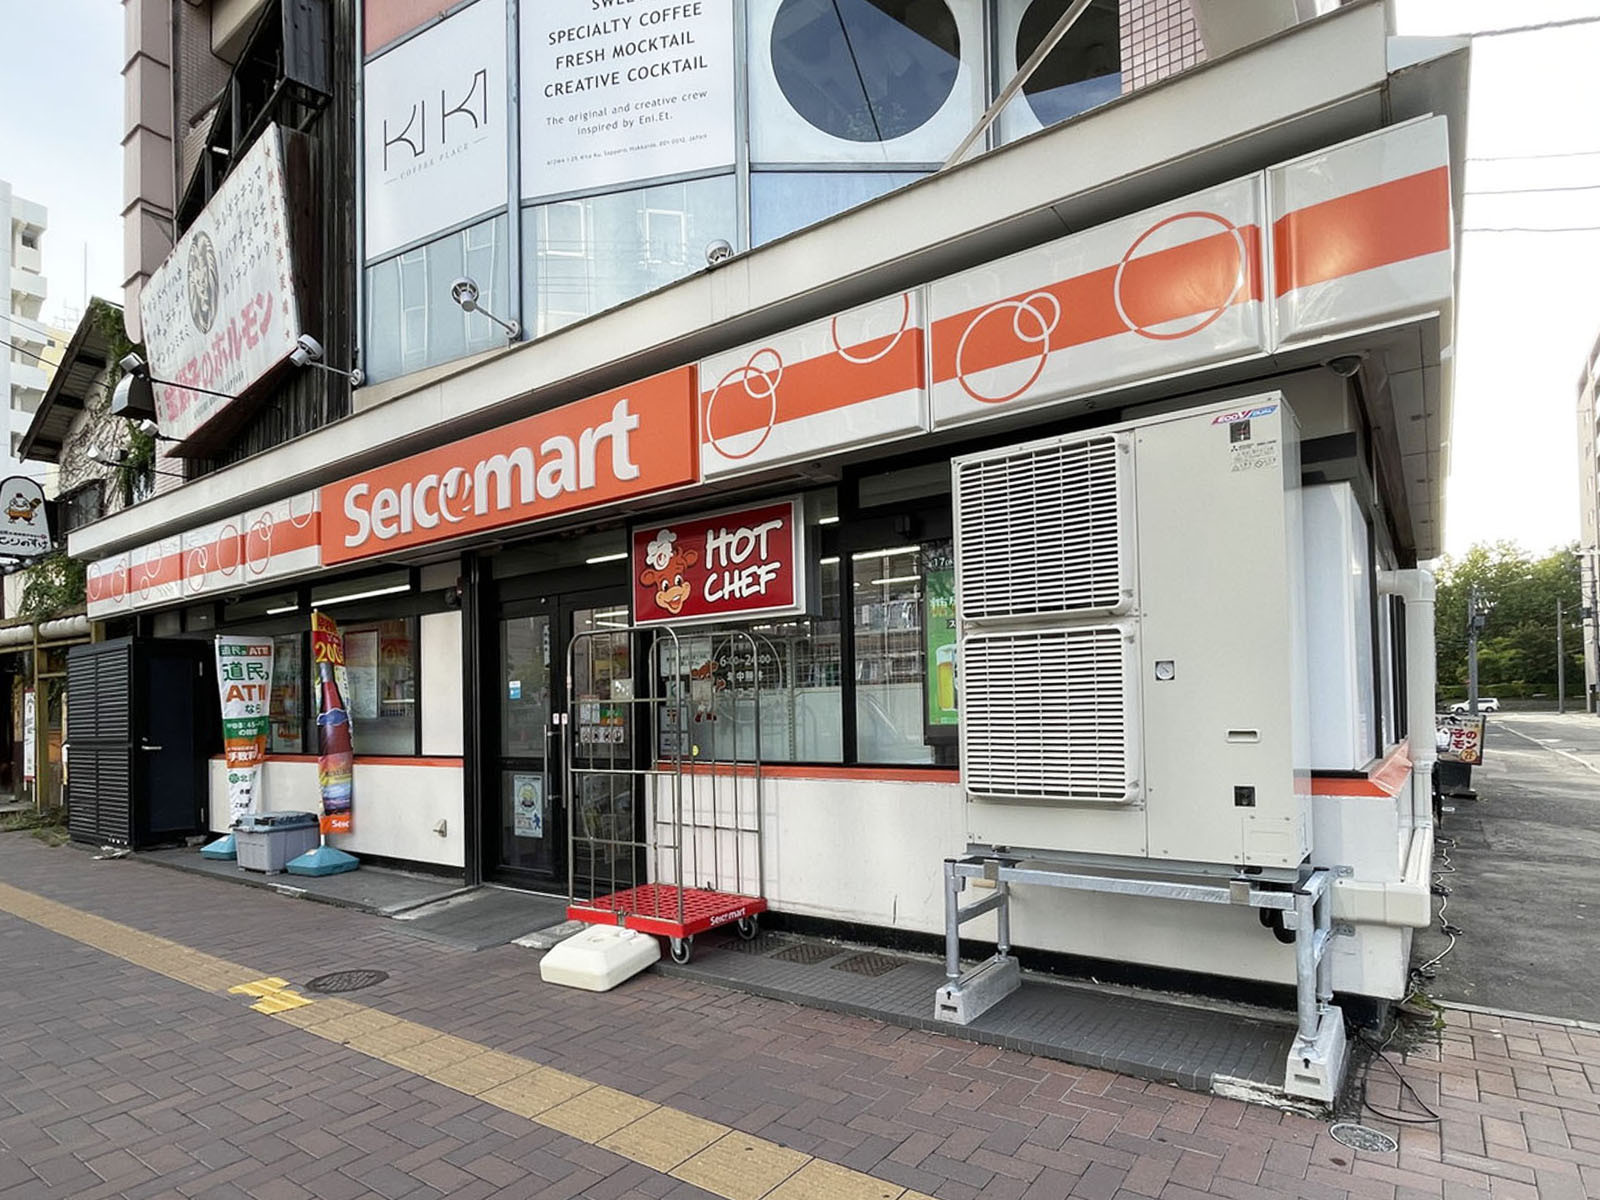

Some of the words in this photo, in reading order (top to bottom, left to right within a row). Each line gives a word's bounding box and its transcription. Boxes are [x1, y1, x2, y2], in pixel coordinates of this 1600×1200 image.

[548, 16, 633, 46] SPECIALTY
[639, 1, 703, 27] COFFEE
[555, 48, 605, 70] FRESH
[612, 31, 695, 59] MOCKTAIL
[544, 71, 620, 98] CREATIVE
[627, 55, 708, 82] COCKTAIL
[546, 116, 564, 126] The
[568, 107, 608, 123] original
[611, 103, 630, 115] and
[634, 94, 677, 110] creative
[681, 90, 708, 102] crew
[577, 120, 618, 136] inspired
[622, 116, 634, 129] by
[343, 398, 640, 549] Seicomart
[705, 519, 783, 570] HOT
[704, 561, 781, 602] CHEF
